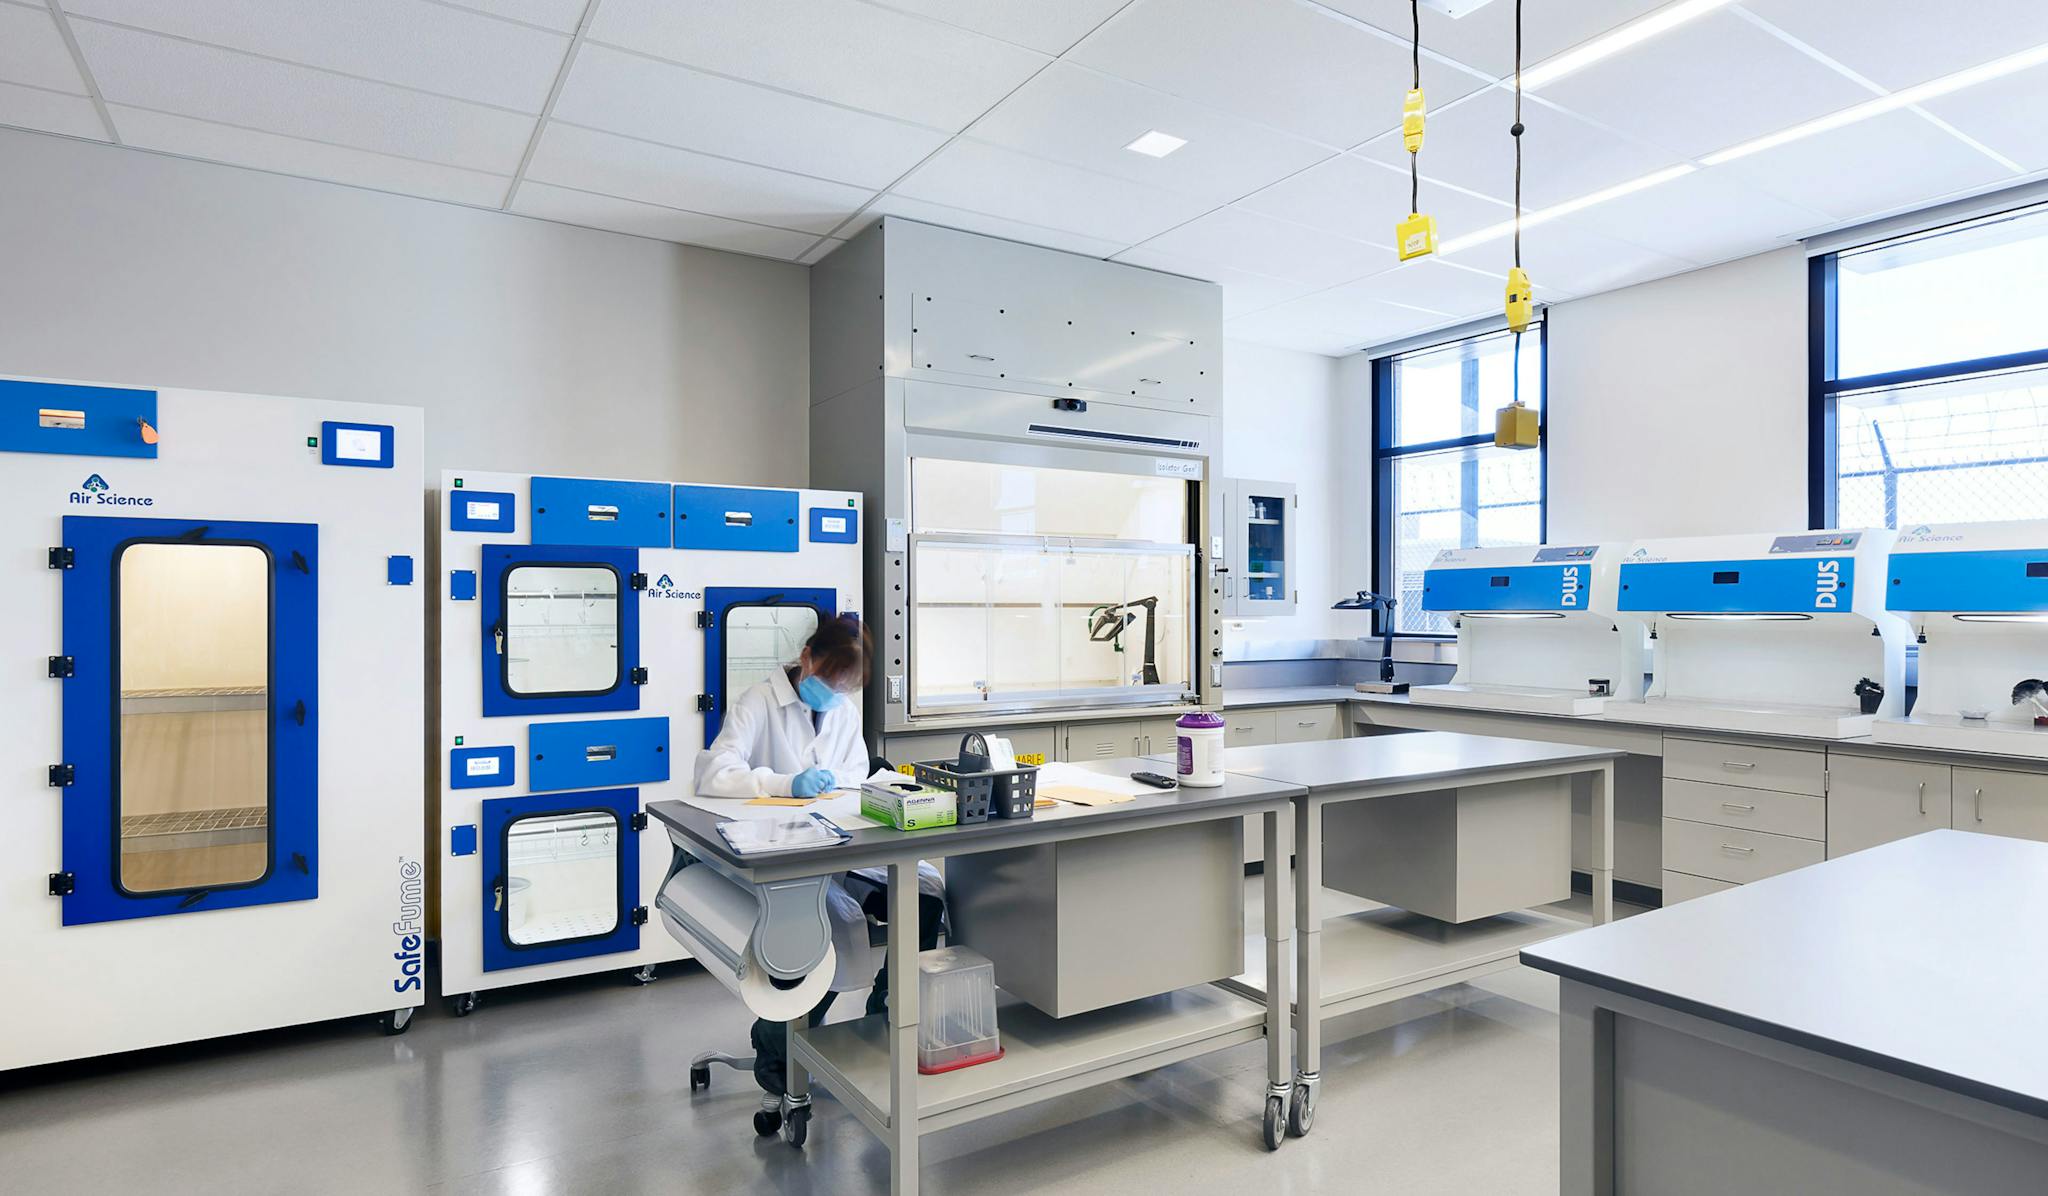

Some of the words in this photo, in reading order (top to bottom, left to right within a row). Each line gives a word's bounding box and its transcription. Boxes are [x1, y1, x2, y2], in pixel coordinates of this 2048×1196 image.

[69, 492, 92, 504] Air
[96, 493, 154, 506] Science
[1898, 535, 1915, 543] Air
[1919, 534, 1964, 542] Science
[1561, 566, 1579, 607] DWS
[1815, 560, 1840, 609] DWS
[648, 588, 663, 598] Air
[665, 589, 701, 600] Science
[907, 819, 916, 827] S
